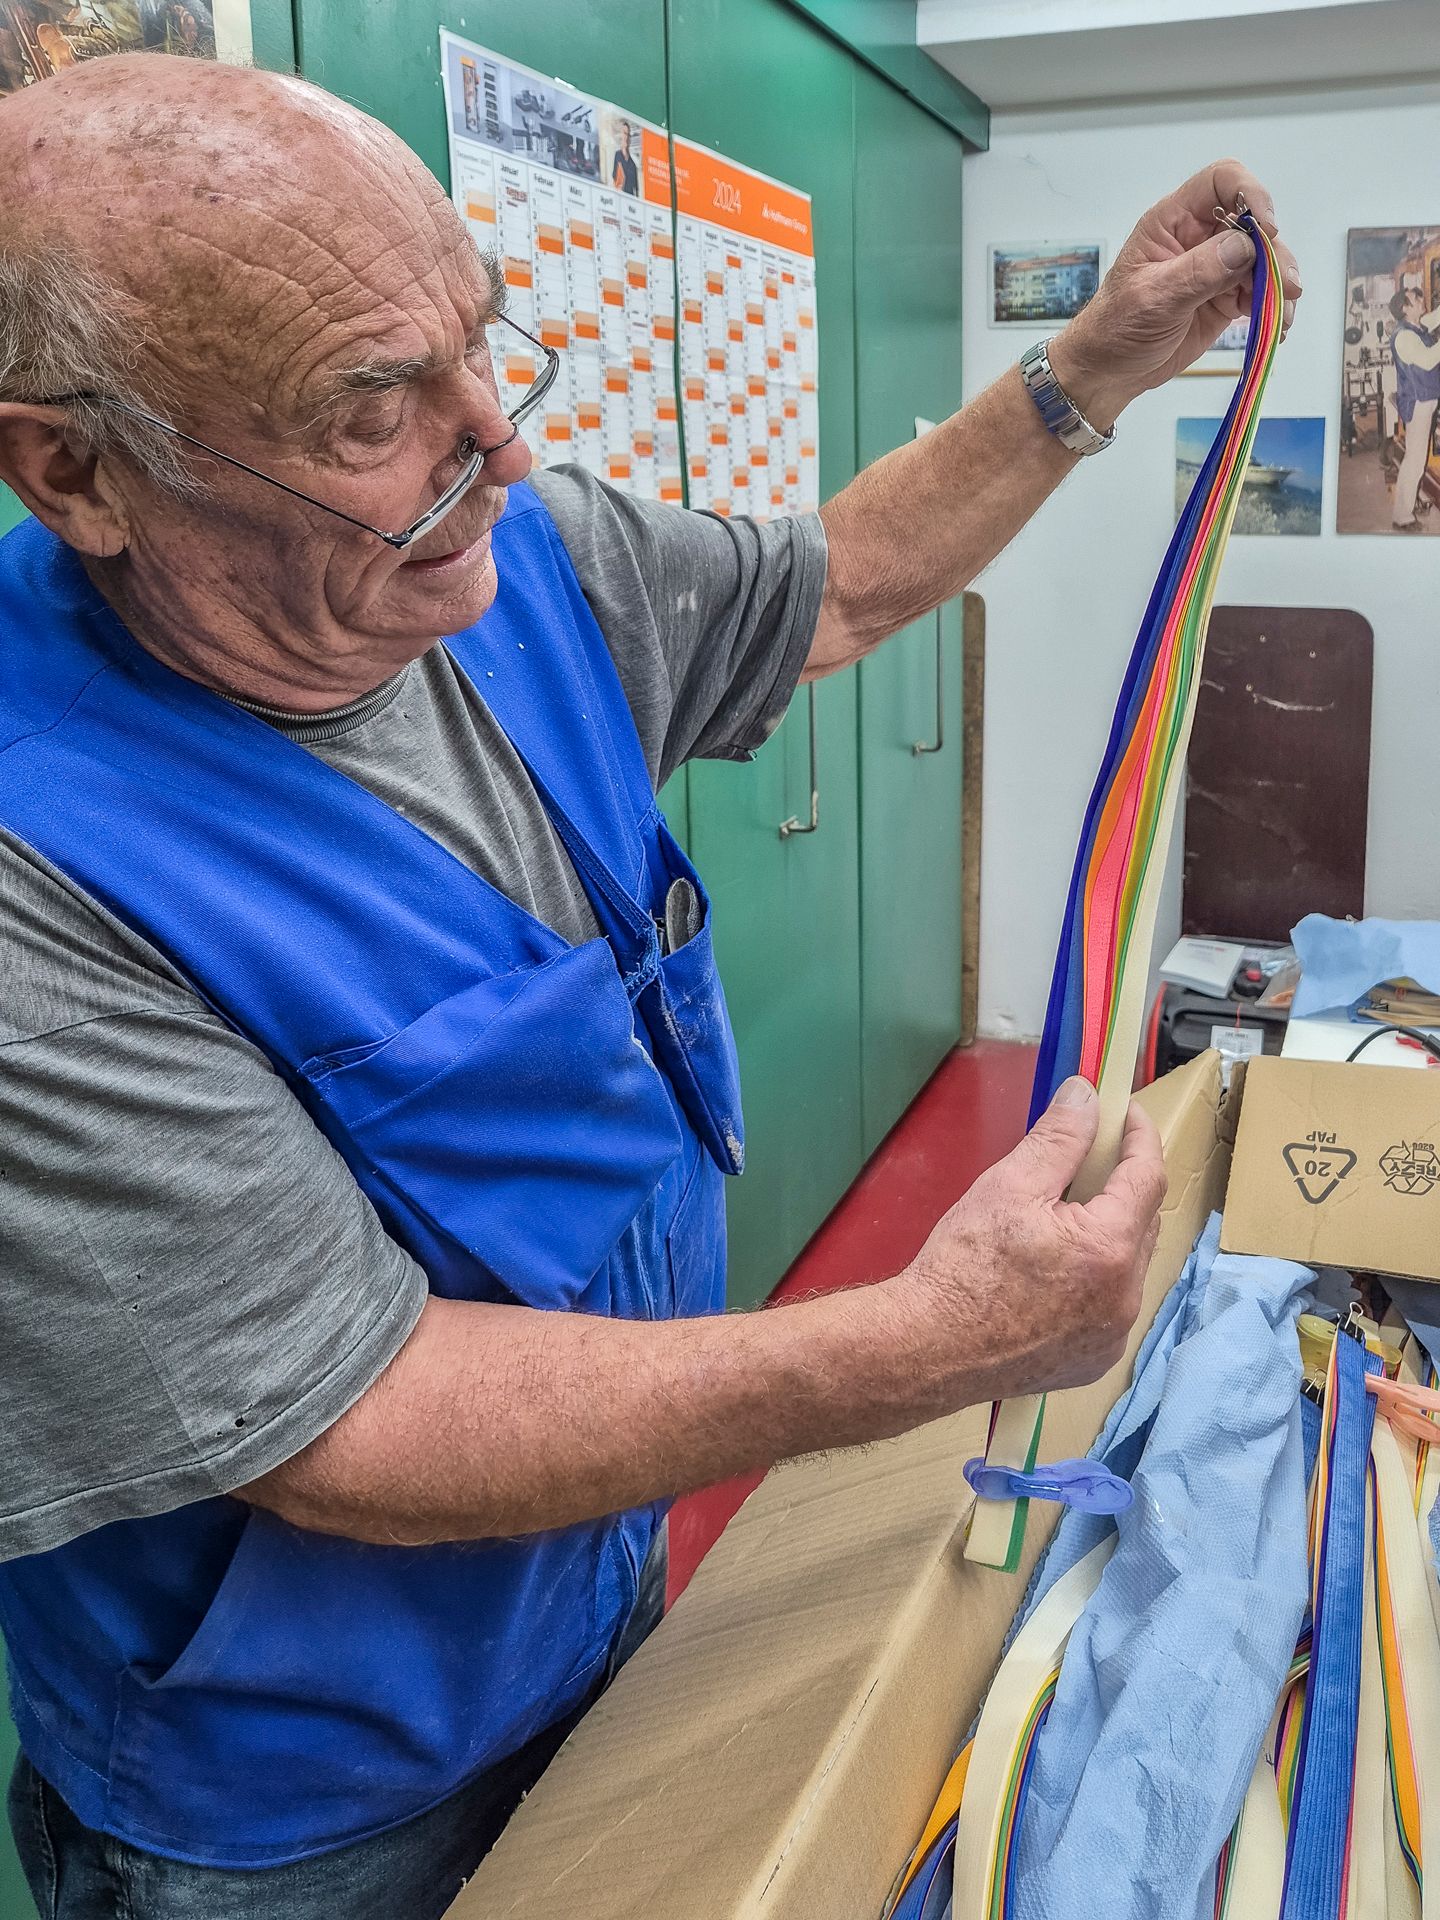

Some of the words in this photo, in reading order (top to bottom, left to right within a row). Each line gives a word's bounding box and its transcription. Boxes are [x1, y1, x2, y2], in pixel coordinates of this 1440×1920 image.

[534, 173, 554, 187] Februar
[712, 177, 742, 216] 2024
[1306, 1131, 1337, 1144] PAP
[1304, 1160, 1332, 1177] 20
[1389, 1161, 1437, 1177] RESY
